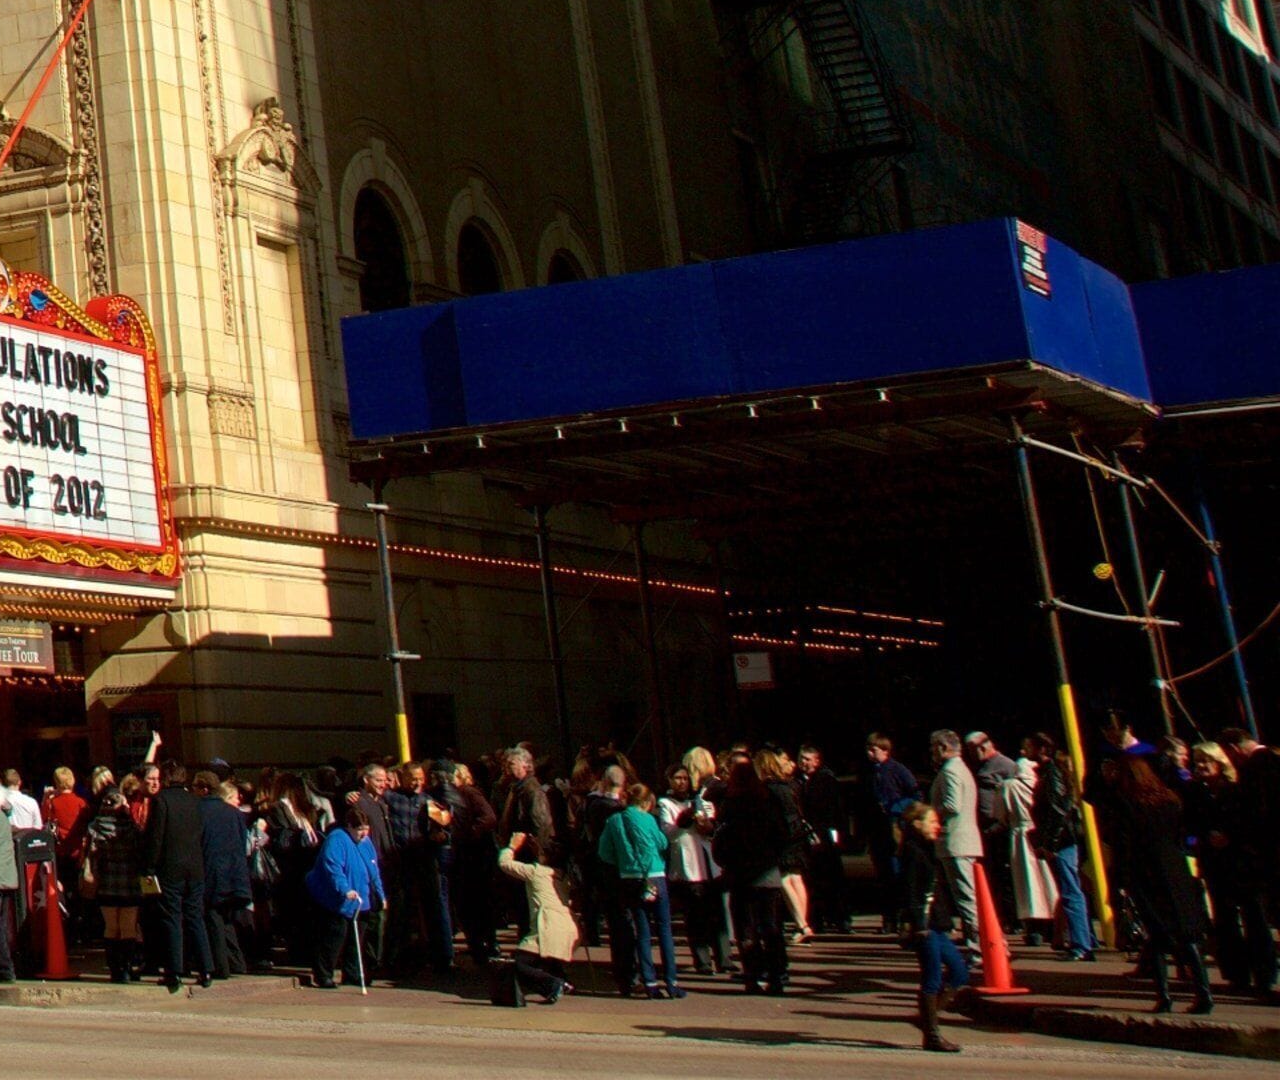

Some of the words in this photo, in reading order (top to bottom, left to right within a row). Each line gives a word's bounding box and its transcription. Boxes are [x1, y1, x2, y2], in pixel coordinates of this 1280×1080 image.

[1, 401, 87, 456] SCHOOL
[3, 465, 35, 510] OF
[50, 473, 108, 520] 2012
[13, 646, 40, 663] TOUR
